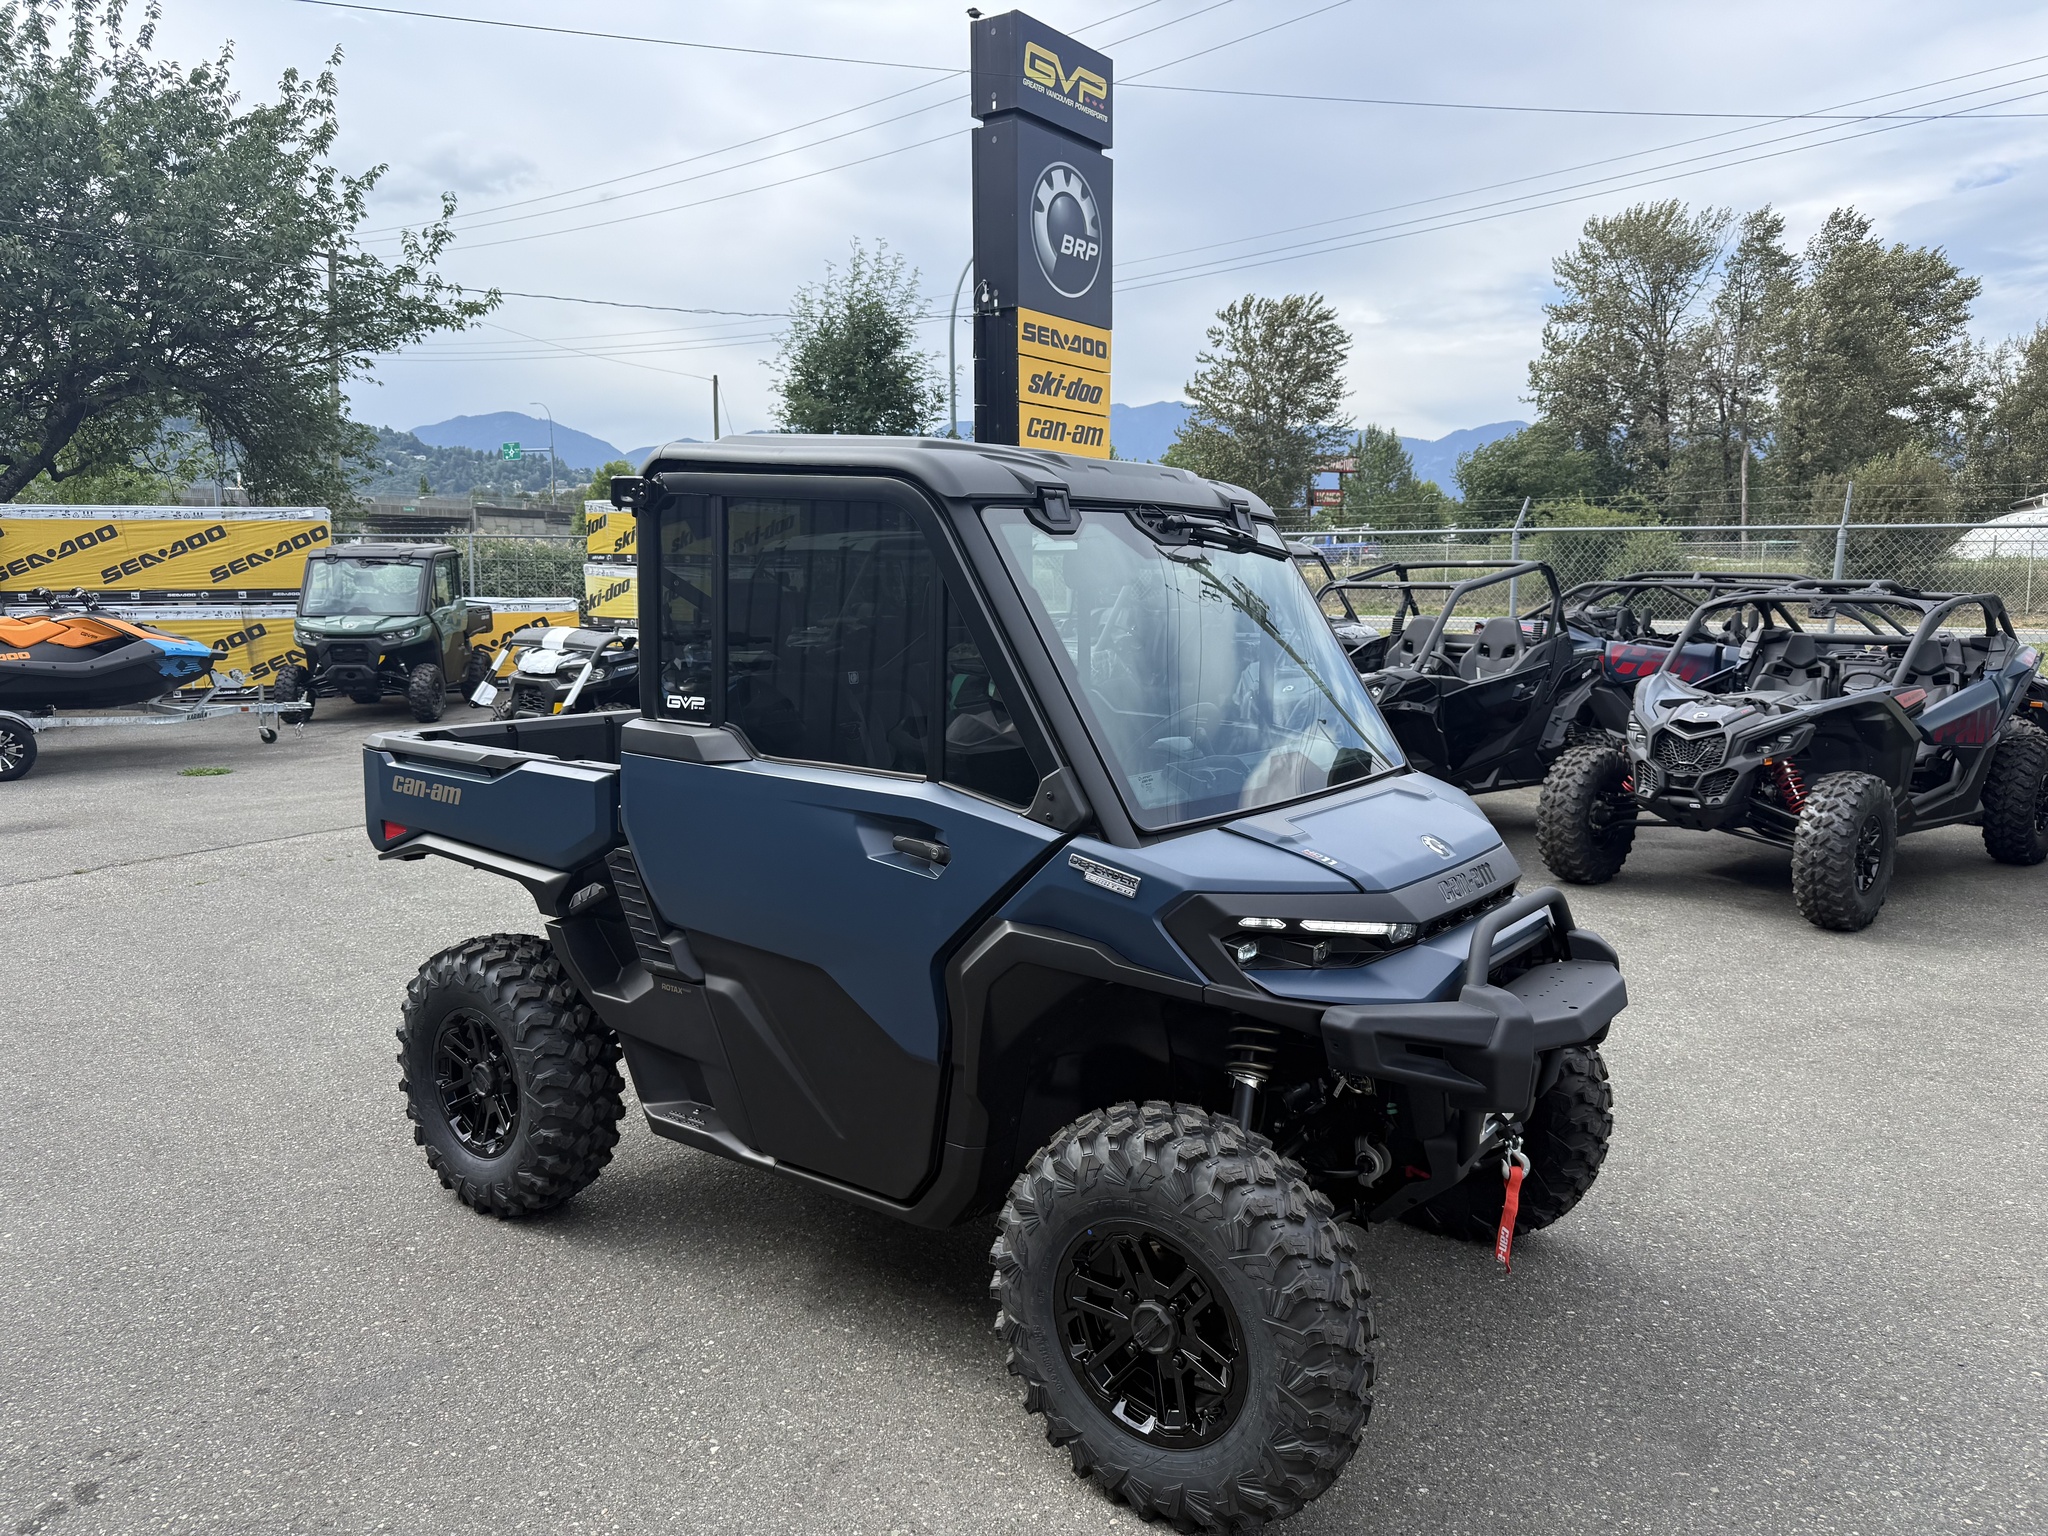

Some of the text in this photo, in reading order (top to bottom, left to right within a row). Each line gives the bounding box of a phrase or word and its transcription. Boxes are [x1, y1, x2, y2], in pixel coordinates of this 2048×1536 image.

[1023, 41, 1107, 104] GVP
[1022, 77, 1109, 123] GREATER VANCOUVER POWERSPORTS
[1060, 233, 1099, 262] BRP
[1027, 370, 1104, 405] ski-doo
[1026, 416, 1104, 447] can-am
[666, 694, 706, 710] GVP
[392, 774, 463, 806] can-am
[1069, 854, 1139, 887] DEFENDER
[1437, 861, 1498, 904] can-am
[661, 982, 683, 995] ROTAX
[1497, 1226, 1510, 1263] can-a
